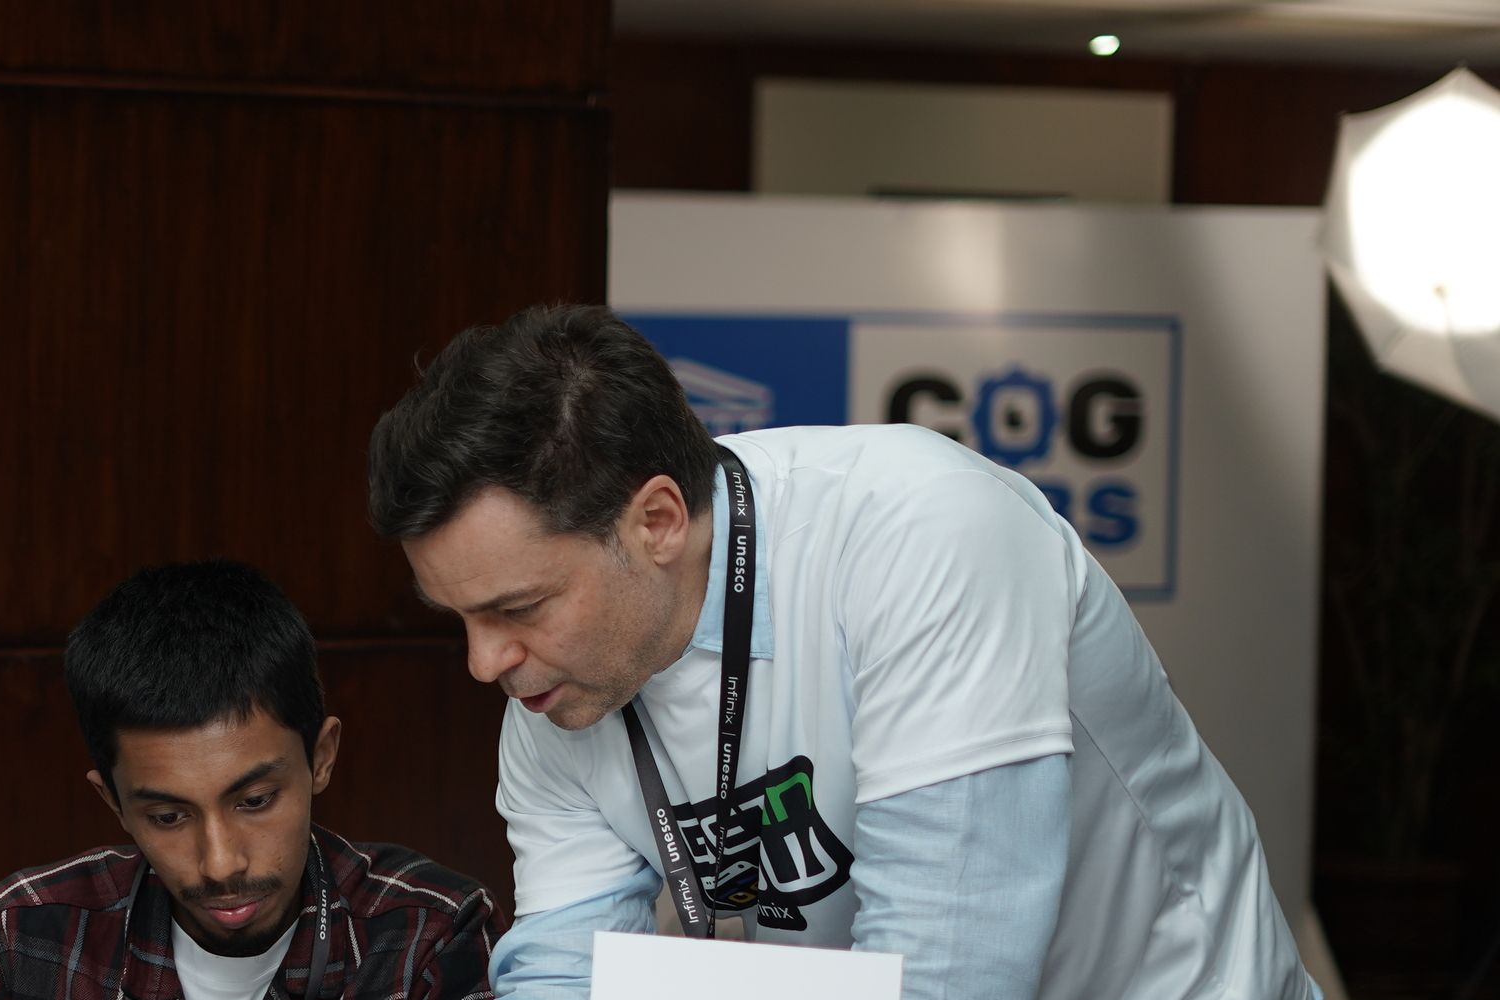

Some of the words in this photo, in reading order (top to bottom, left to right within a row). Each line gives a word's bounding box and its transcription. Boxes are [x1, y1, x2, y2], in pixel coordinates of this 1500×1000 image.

[732, 471, 747, 517] Infinix
[734, 535, 747, 593] unesco
[724, 676, 739, 725] Infinix
[720, 743, 732, 799] unesco
[657, 808, 681, 863] unesco
[676, 878, 700, 923] Infinix
[318, 889, 327, 940] unesco
